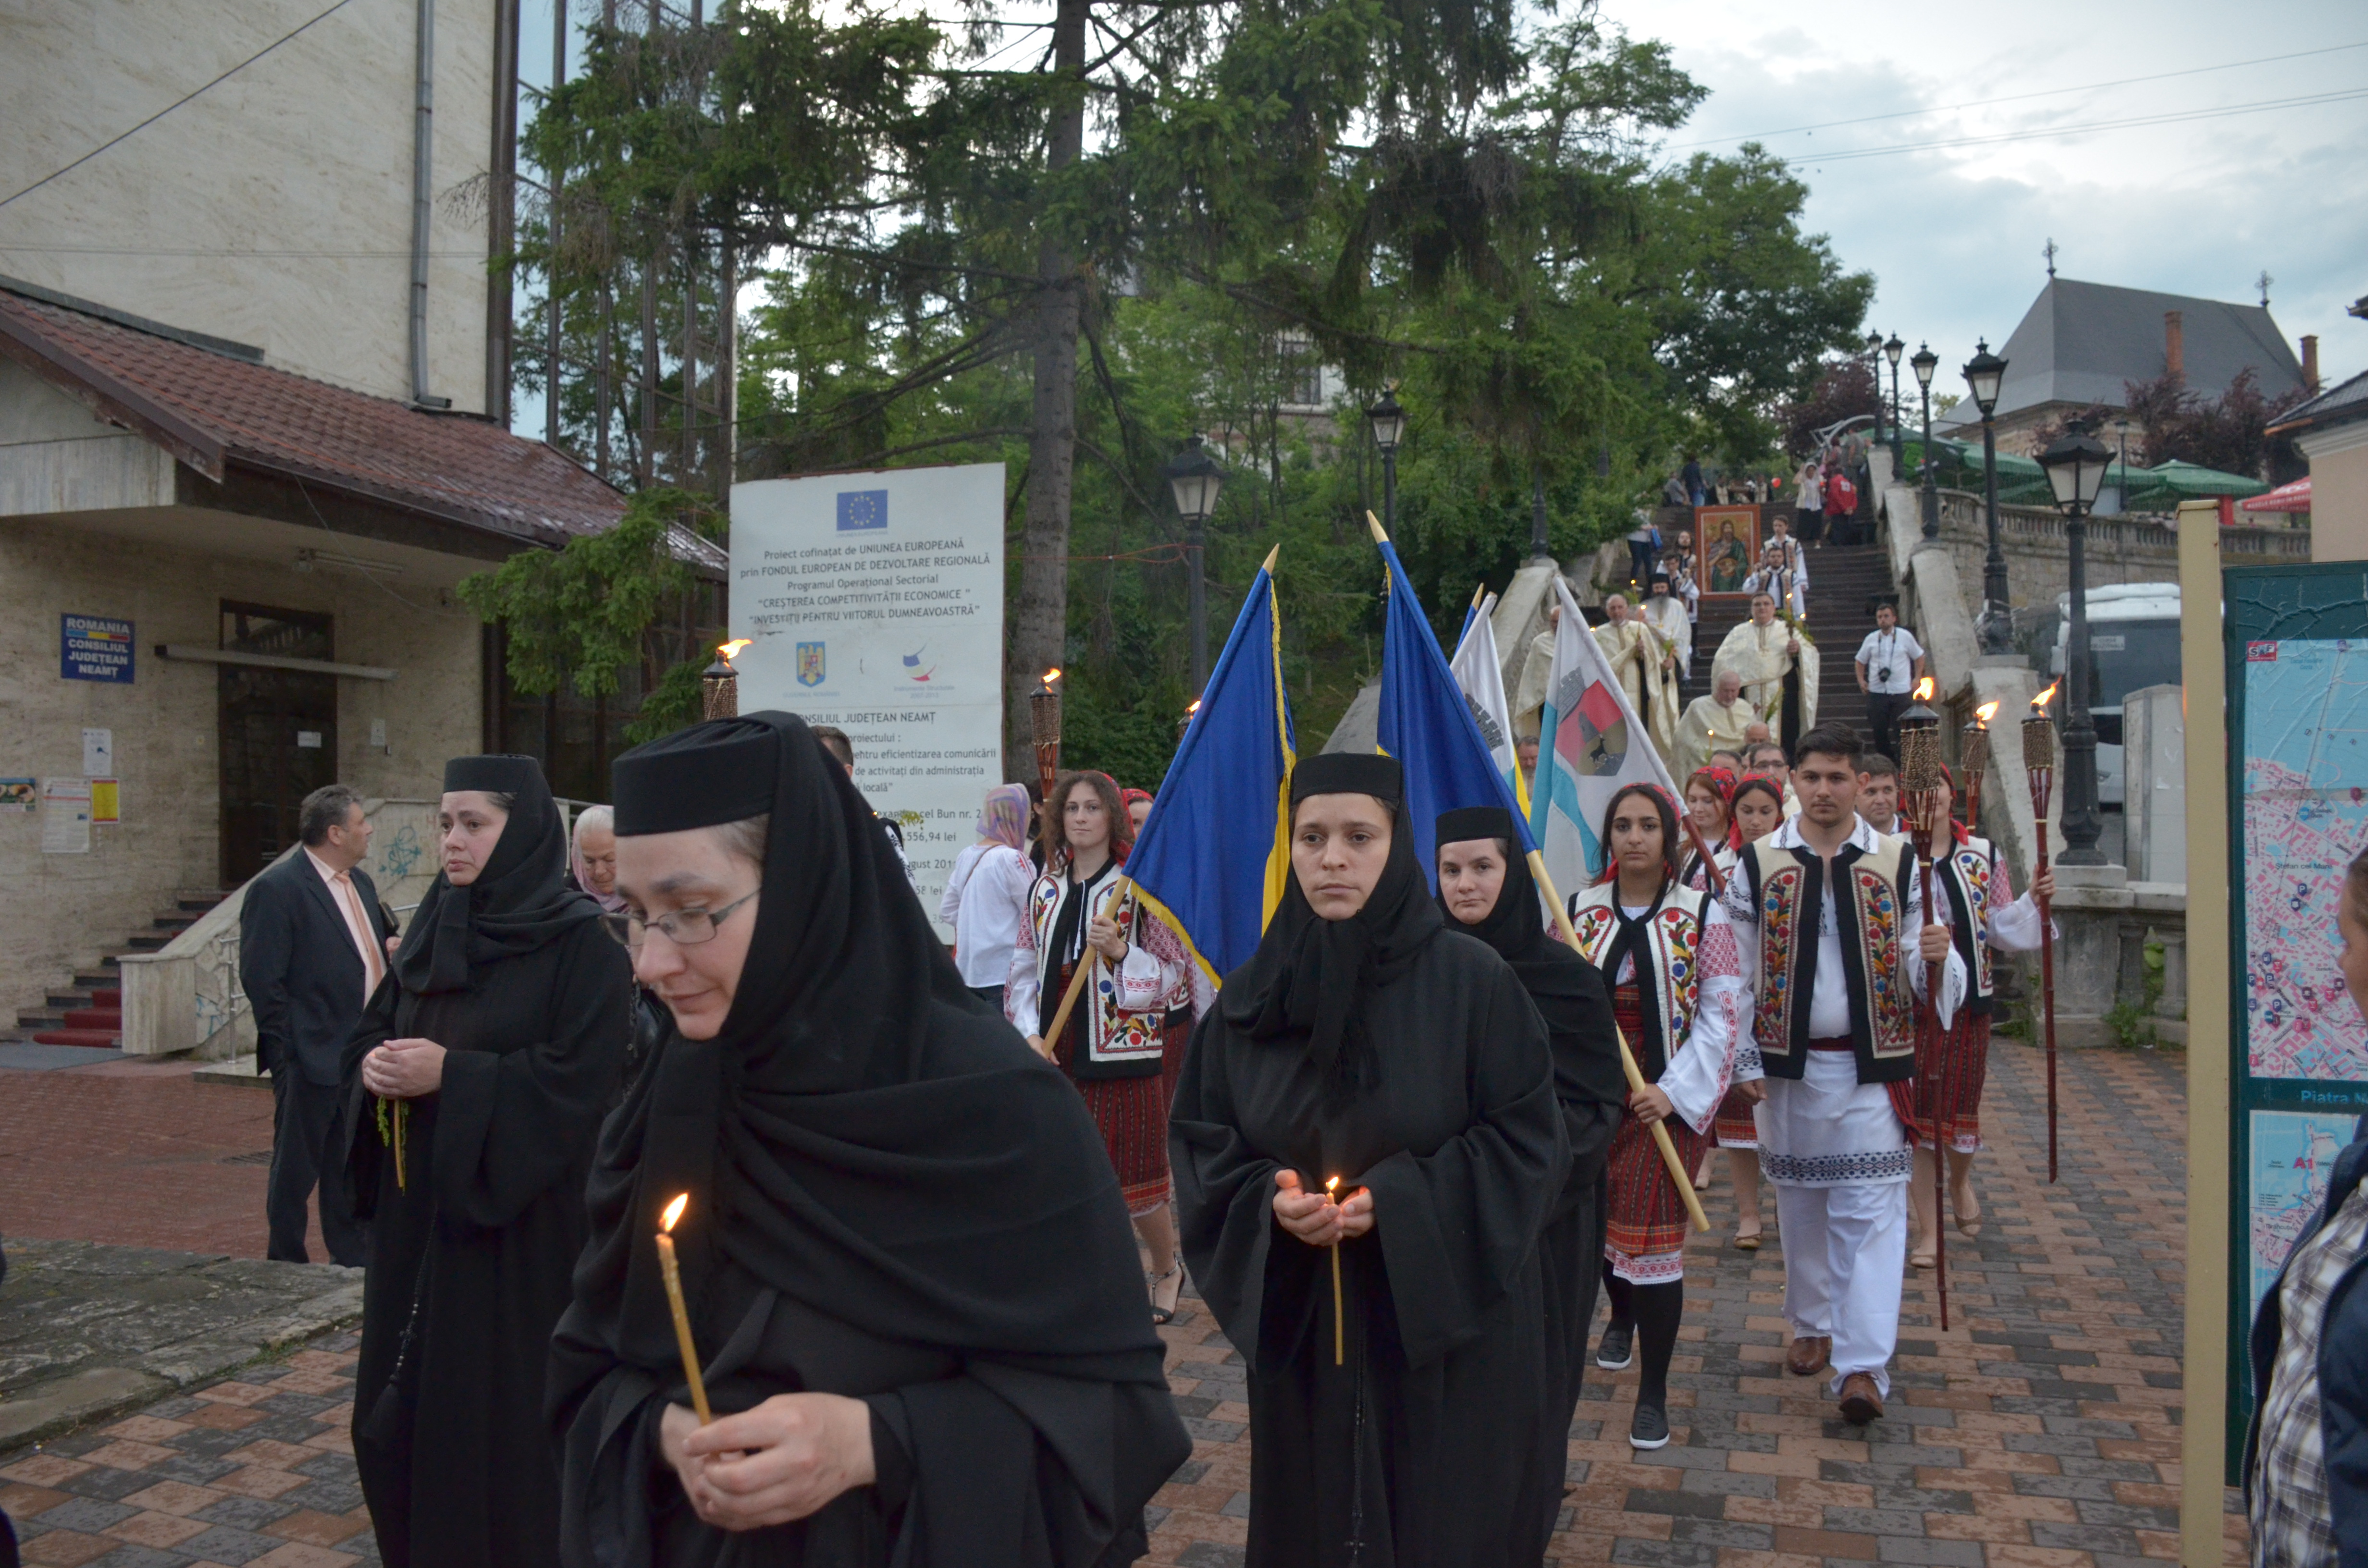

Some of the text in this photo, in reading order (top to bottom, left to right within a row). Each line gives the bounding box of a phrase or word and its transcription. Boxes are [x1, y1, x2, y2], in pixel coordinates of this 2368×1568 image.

[764, 551, 797, 560] Proiect
[845, 546, 856, 555] de
[860, 543, 902, 553] UNIUNEA
[905, 537, 964, 551] EUROPEANĂ
[740, 552, 990, 579] prin FONDUL EUROPEAN DE DEZVOLTARE REGIONALĂ
[788, 574, 938, 592] Programul Operațional Sectorial
[904, 589, 961, 601] ECONOMICE
[802, 611, 839, 622] PENTRU
[842, 609, 885, 620] VIITORUL
[68, 638, 128, 653] CONSILIUL
[800, 713, 840, 724] ONSILIUL
[854, 748, 996, 759] entru eficientizarea comunicării
[854, 766, 865, 776] de
[909, 766, 923, 775] din
[925, 765, 984, 777] administrația
[920, 809, 933, 819] cel
[937, 809, 955, 819] Bun
[959, 810, 971, 819] nr.
[944, 832, 956, 841] lei
[909, 860, 930, 870] ugust
[930, 886, 942, 895] lei
[2301, 1090, 2349, 1104] Piatra
[2293, 1156, 2314, 1170] A1
